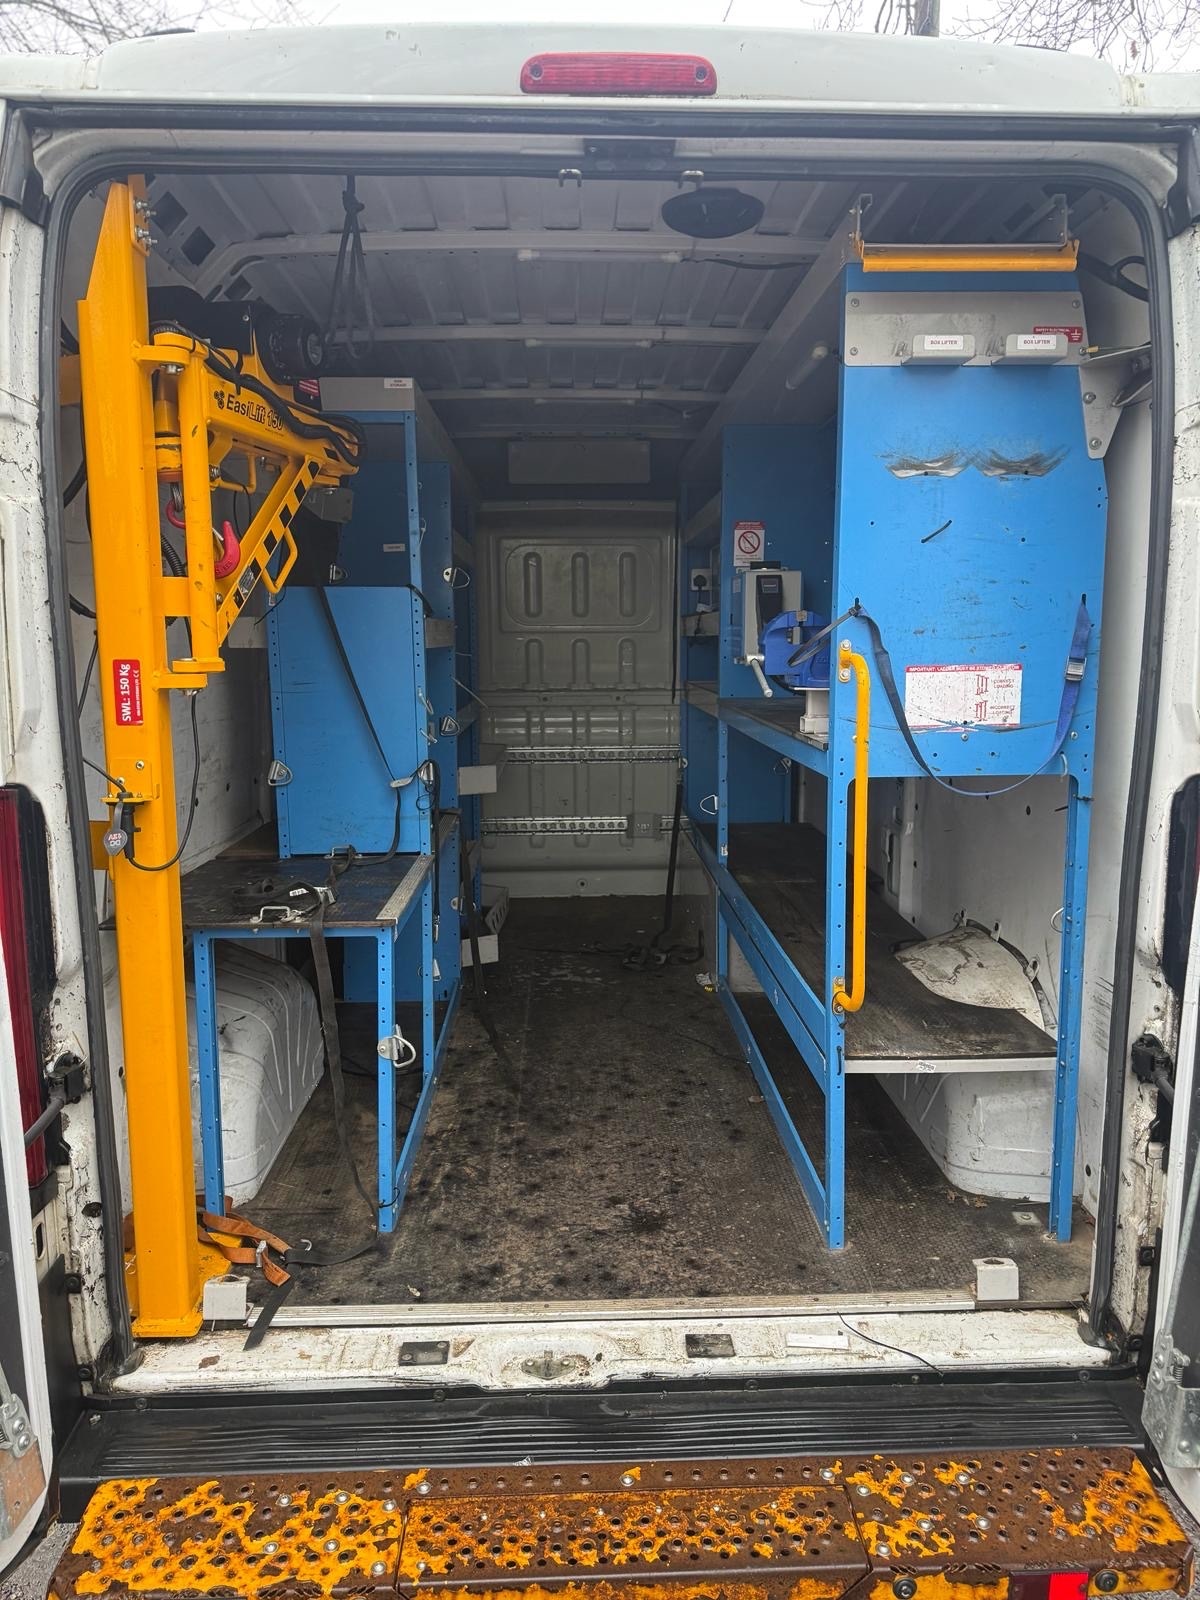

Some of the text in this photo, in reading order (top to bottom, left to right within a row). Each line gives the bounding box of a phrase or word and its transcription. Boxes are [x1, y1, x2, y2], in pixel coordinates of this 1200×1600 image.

[267, 408, 284, 430] 150
[120, 663, 132, 722] SWL: 150 Kg
